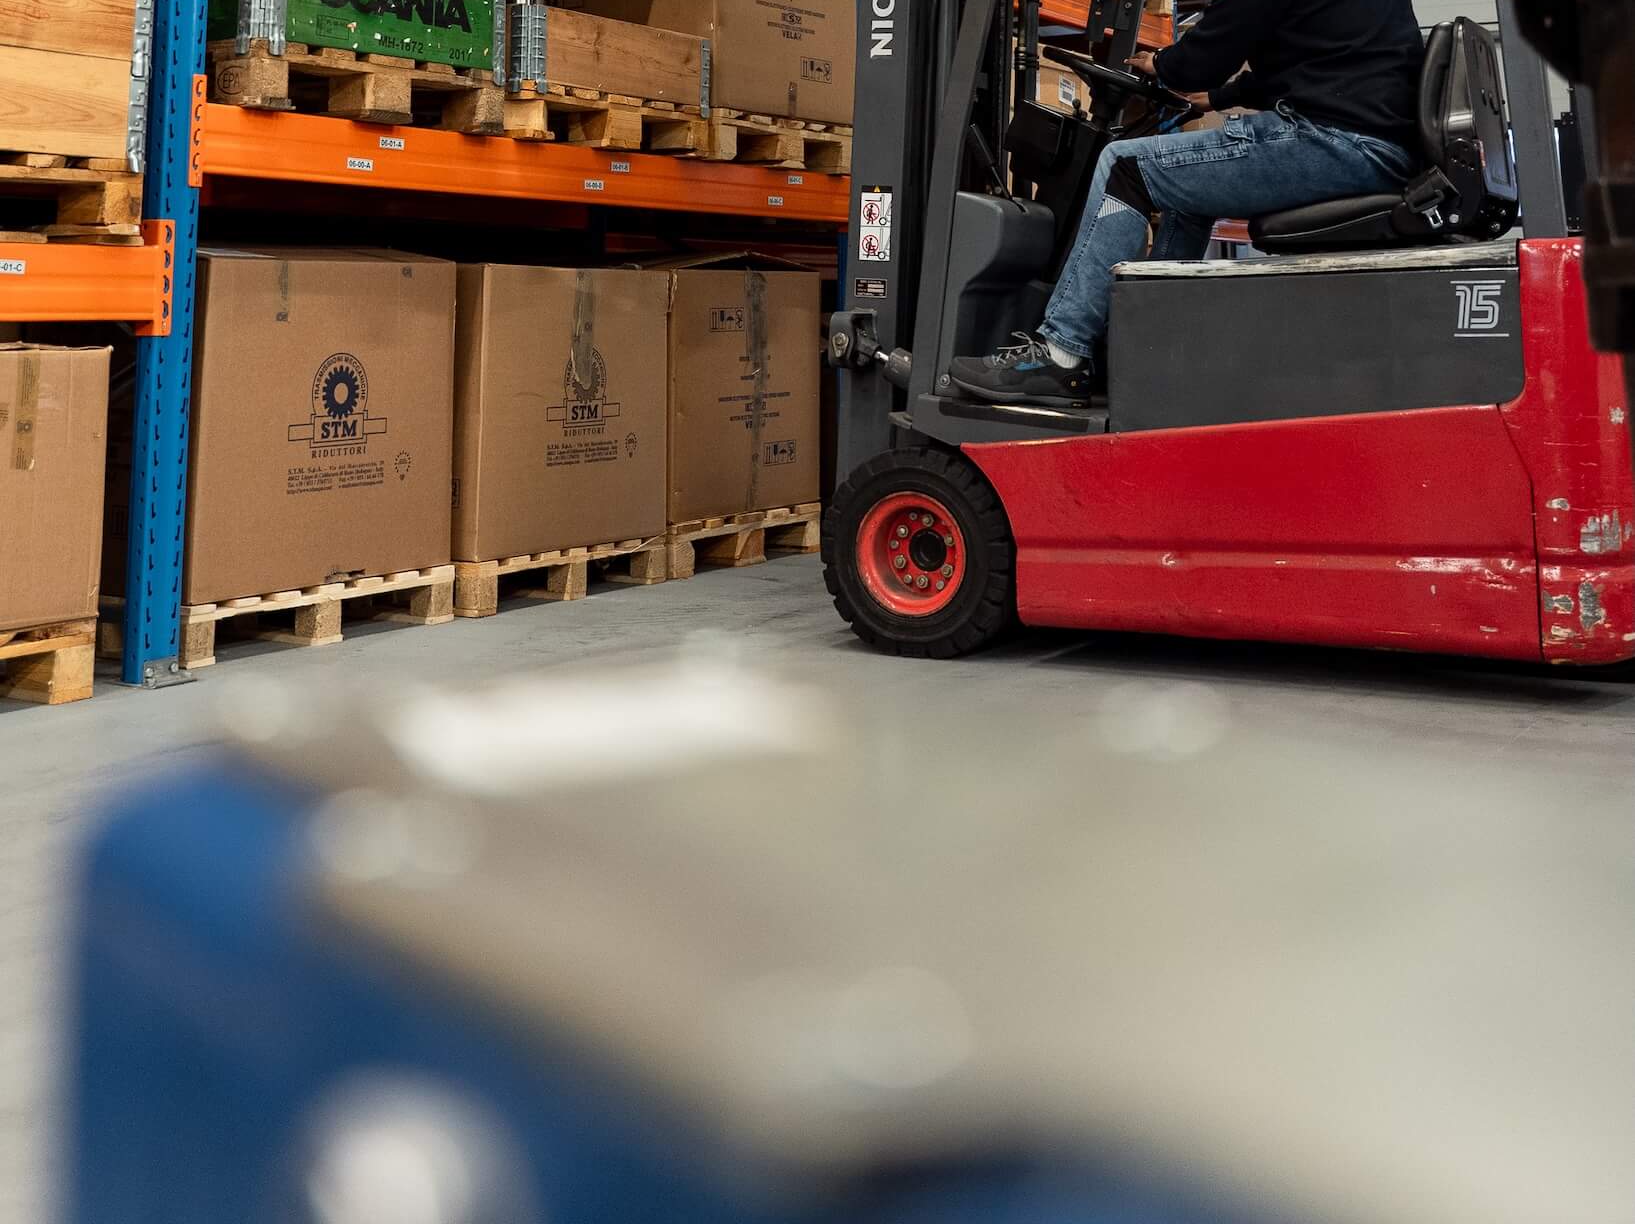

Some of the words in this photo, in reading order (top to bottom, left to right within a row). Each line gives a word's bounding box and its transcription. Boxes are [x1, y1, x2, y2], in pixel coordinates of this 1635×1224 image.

[1456, 285, 1501, 329] 15
[570, 404, 599, 421] STM
[321, 419, 358, 440] STM
[563, 427, 606, 437] RIDUTTORI
[311, 446, 367, 459] RIDUTTORI
